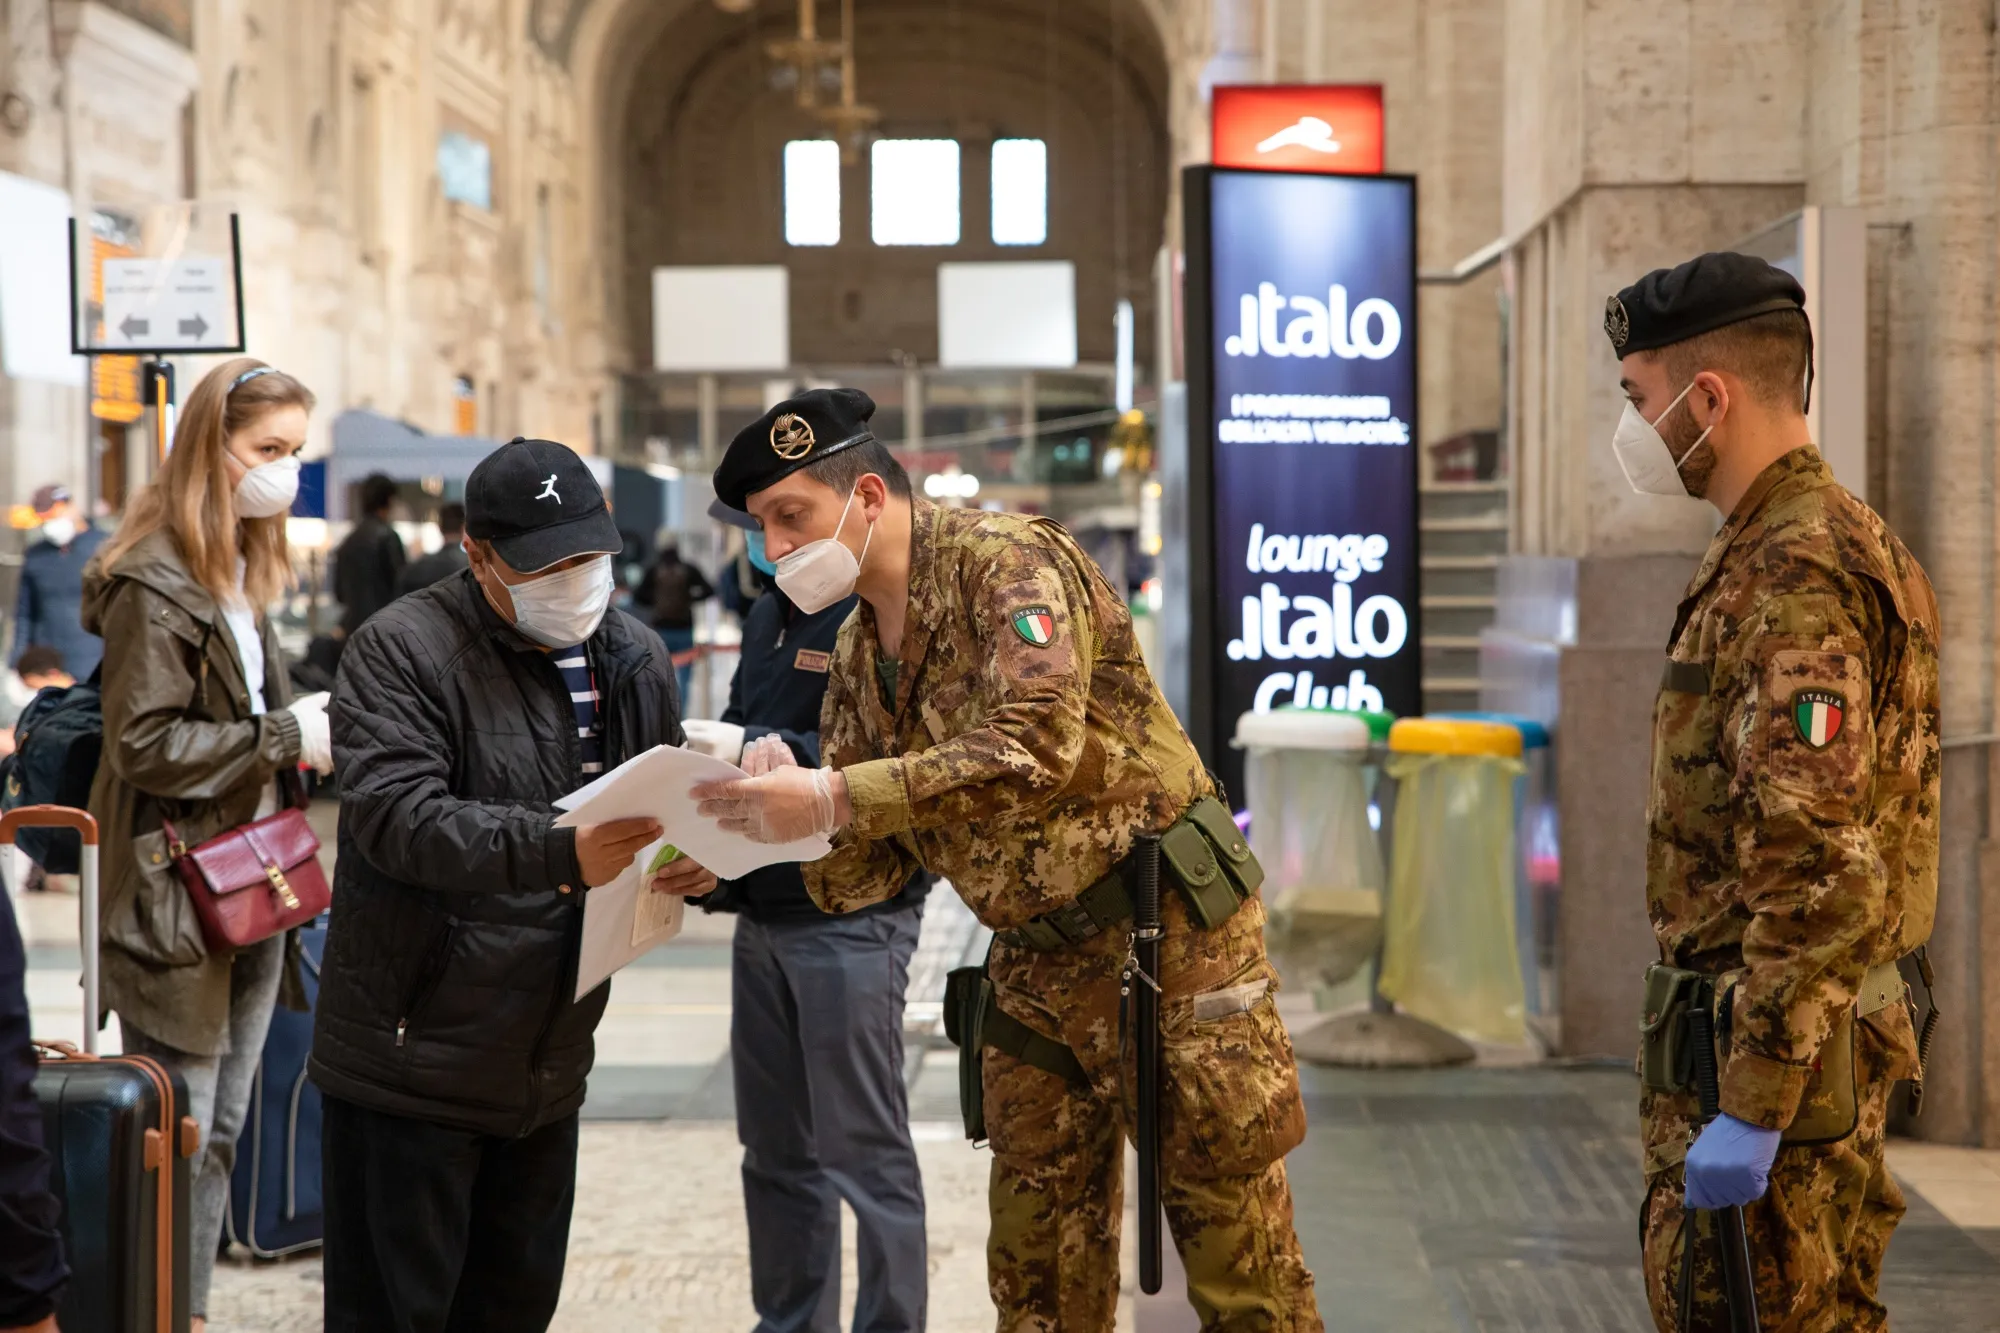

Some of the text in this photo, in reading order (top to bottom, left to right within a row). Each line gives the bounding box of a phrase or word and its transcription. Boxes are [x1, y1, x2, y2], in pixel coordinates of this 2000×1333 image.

[1246, 522, 1389, 583] lounge
[1016, 609, 1047, 619] ITALIA
[1802, 694, 1841, 708] ITALIA
